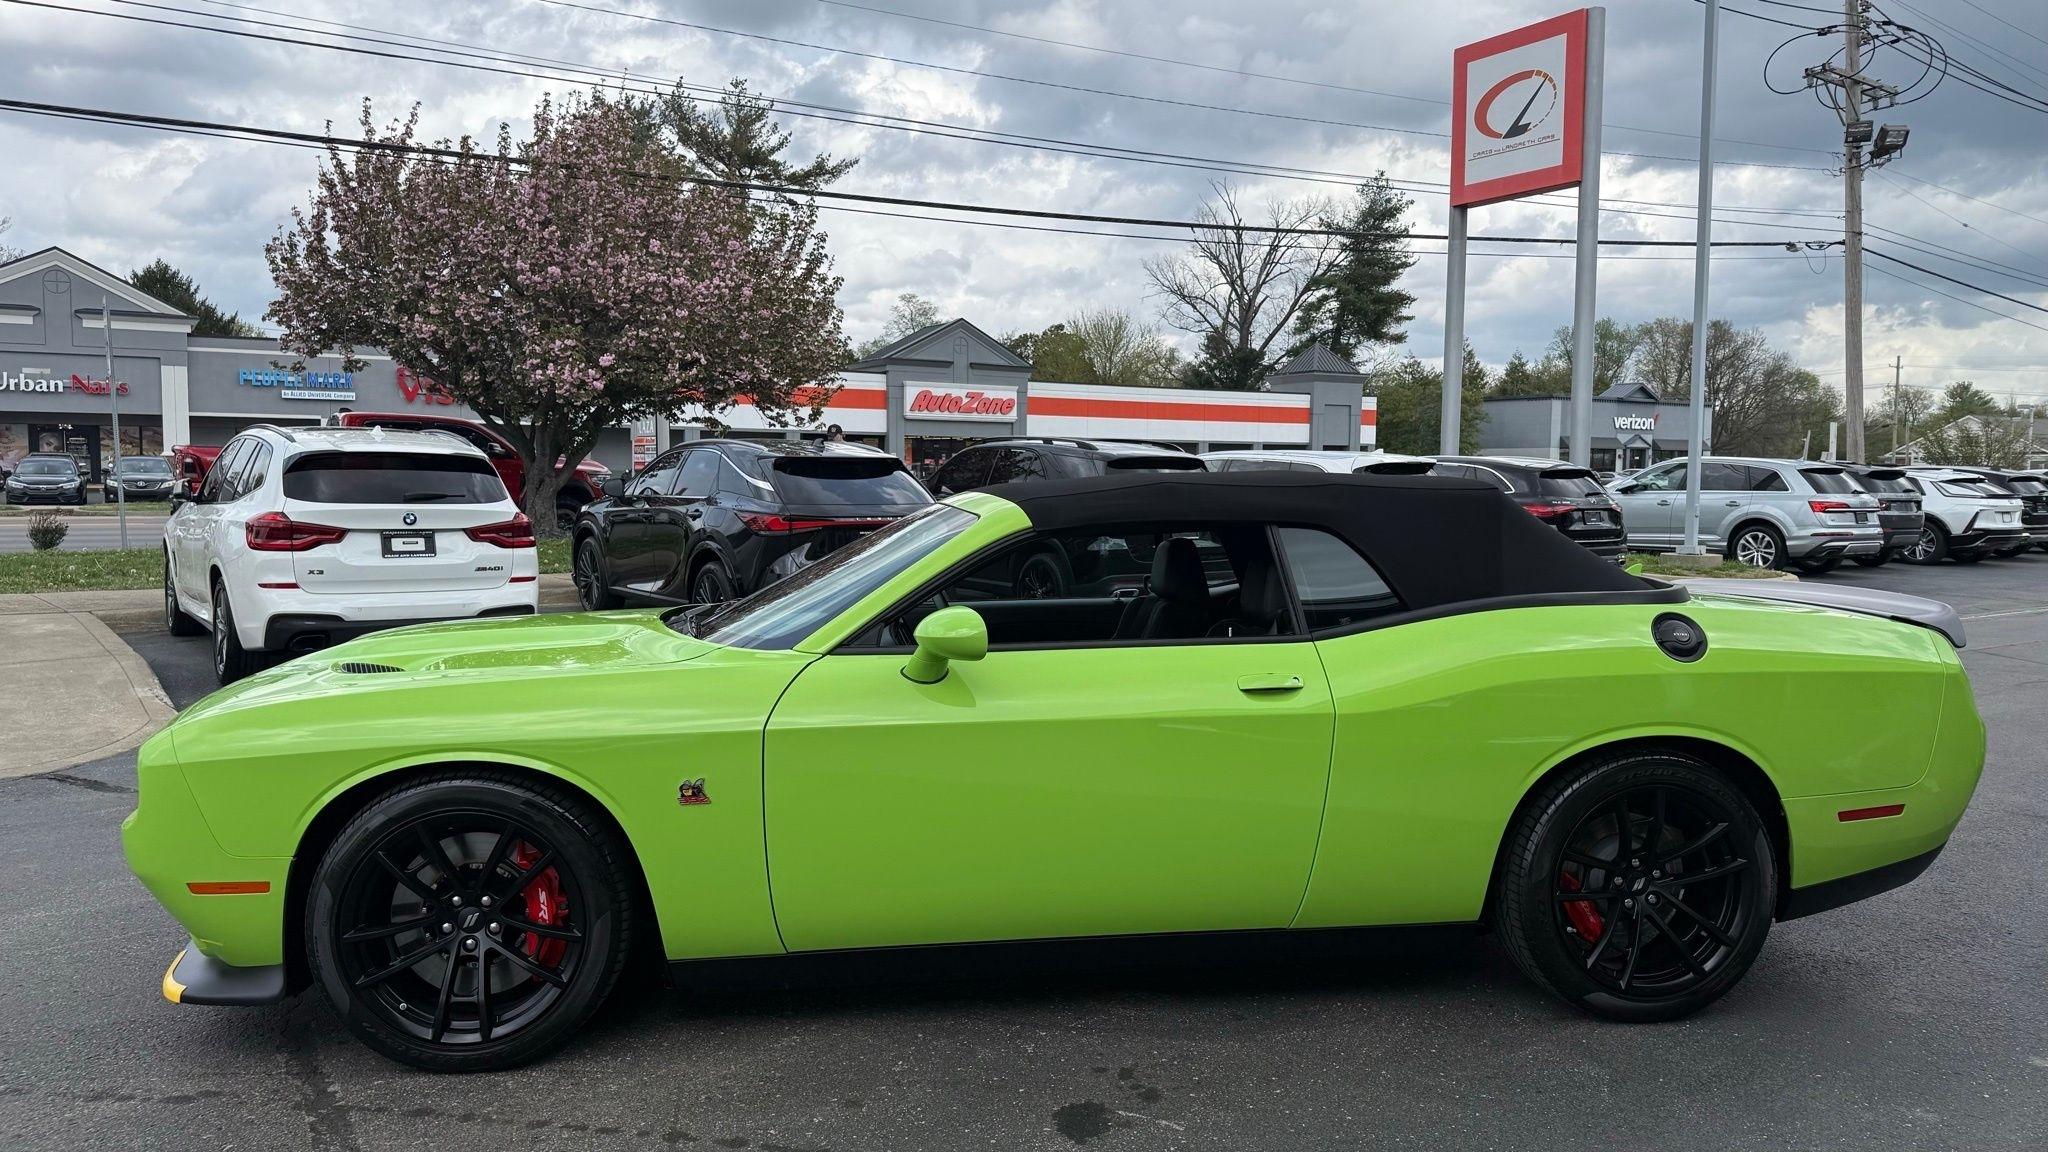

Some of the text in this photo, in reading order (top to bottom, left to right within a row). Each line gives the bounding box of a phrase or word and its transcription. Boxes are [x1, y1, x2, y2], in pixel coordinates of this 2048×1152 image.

[1501, 139, 1536, 151] LANDRETH
[70, 374, 129, 395] Nais
[239, 369, 353, 388] PEOPLE MARK
[910, 389, 1016, 415] AutoZone
[1613, 413, 1655, 430] verizon
[538, 887, 549, 925] SR
